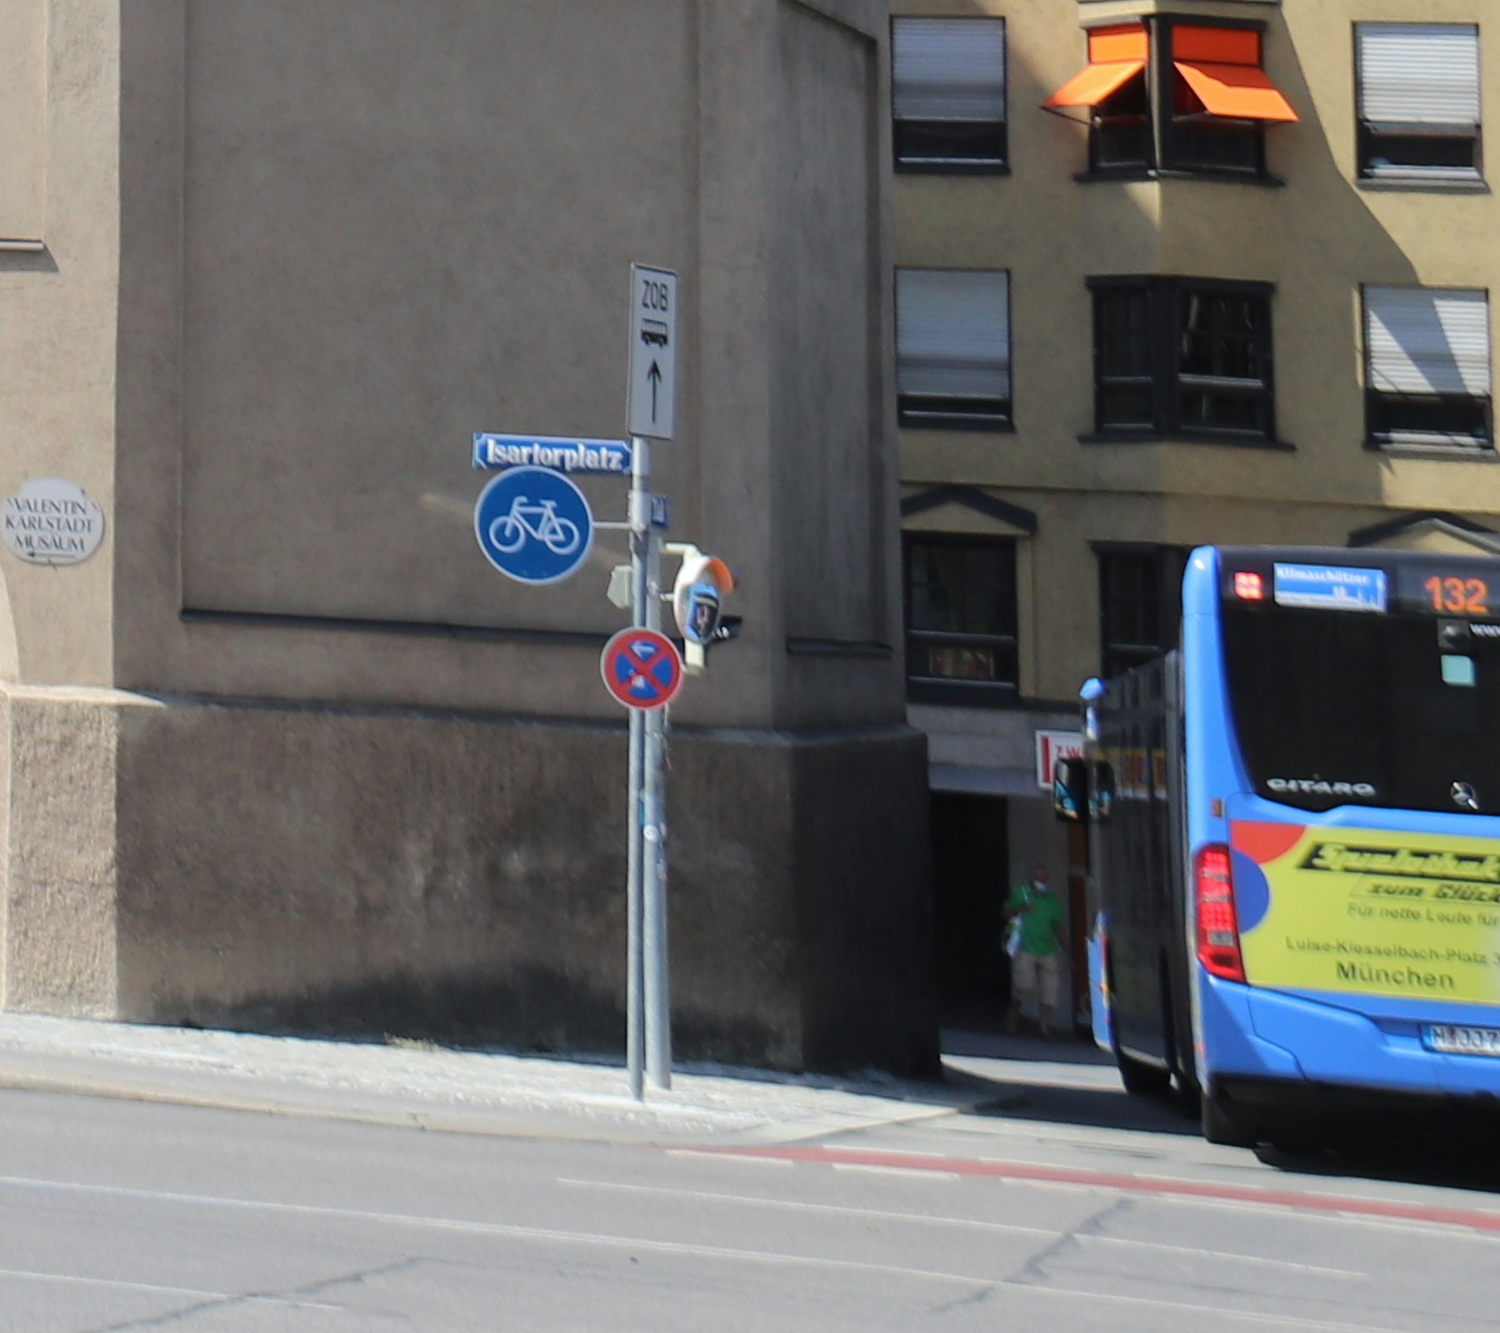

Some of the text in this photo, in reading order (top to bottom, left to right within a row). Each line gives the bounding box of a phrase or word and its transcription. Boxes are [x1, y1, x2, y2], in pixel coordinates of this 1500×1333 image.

[642, 279, 668, 311] ZOB
[486, 438, 624, 471] Isartorplatz
[13, 497, 87, 514] VALENTIN
[6, 515, 92, 533] KARLSTADT
[1276, 566, 1370, 585] Klimaschützer
[1425, 576, 1488, 613] 132
[1266, 778, 1376, 796] CITARO
[1348, 902, 1374, 917] Für
[1380, 906, 1421, 921] nette
[1426, 908, 1472, 925] Leute
[1285, 935, 1487, 964] Luise-Kiesselbach-Platz
[1335, 959, 1455, 988] München
